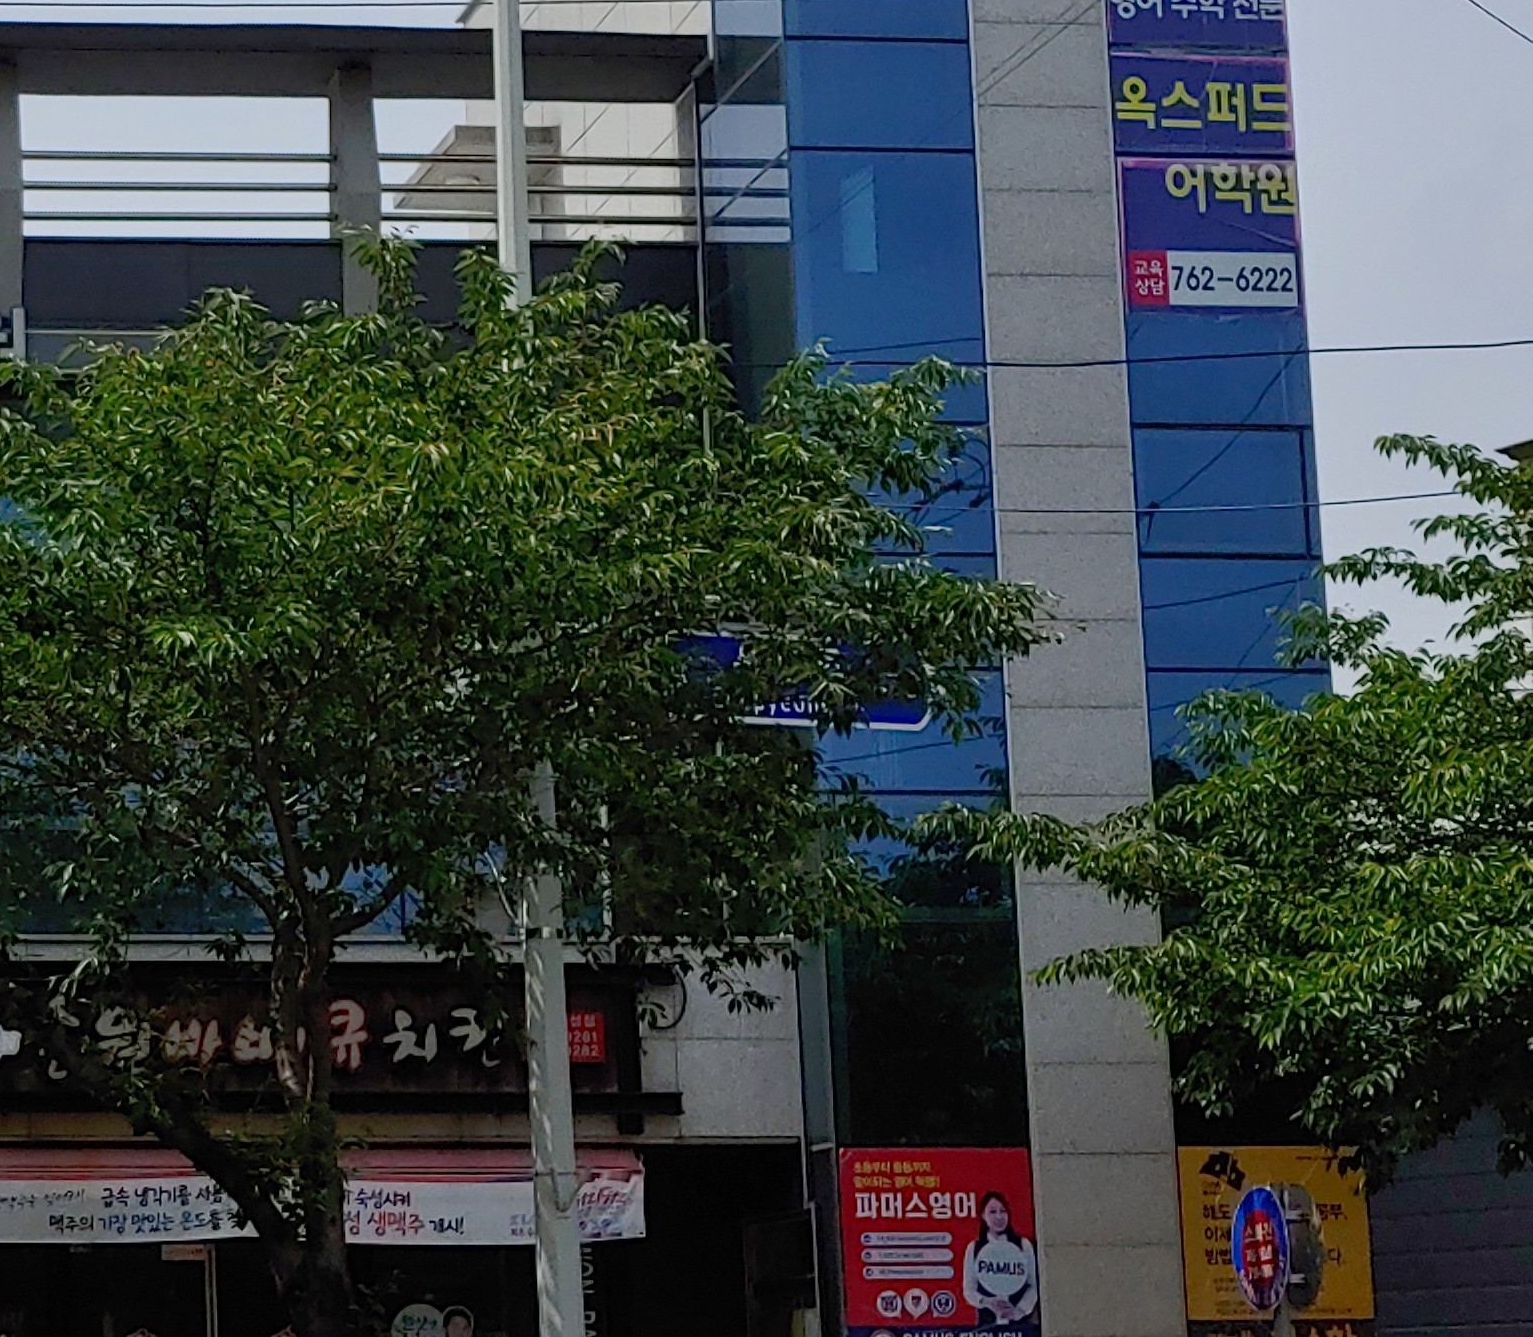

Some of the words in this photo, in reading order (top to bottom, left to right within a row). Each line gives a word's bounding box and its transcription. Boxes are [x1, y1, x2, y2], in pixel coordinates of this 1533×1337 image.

[1115, 76, 1291, 132] 옥스퍼드
[1166, 163, 1296, 215] 어학원
[1134, 260, 1164, 277] 교육
[1171, 265, 1294, 293] 762-6222
[1134, 277, 1164, 295] 상담
[101, 1186, 130, 1207] 급속
[134, 1184, 191, 1207] 냉각기를
[855, 1191, 977, 1220] 파머스영어
[49, 1214, 94, 1234] 맥주의
[99, 1212, 128, 1234] 가장
[131, 1211, 175, 1233] 맛있는
[367, 1210, 425, 1236] 생맥주
[978, 1260, 1025, 1275] PAMUS
